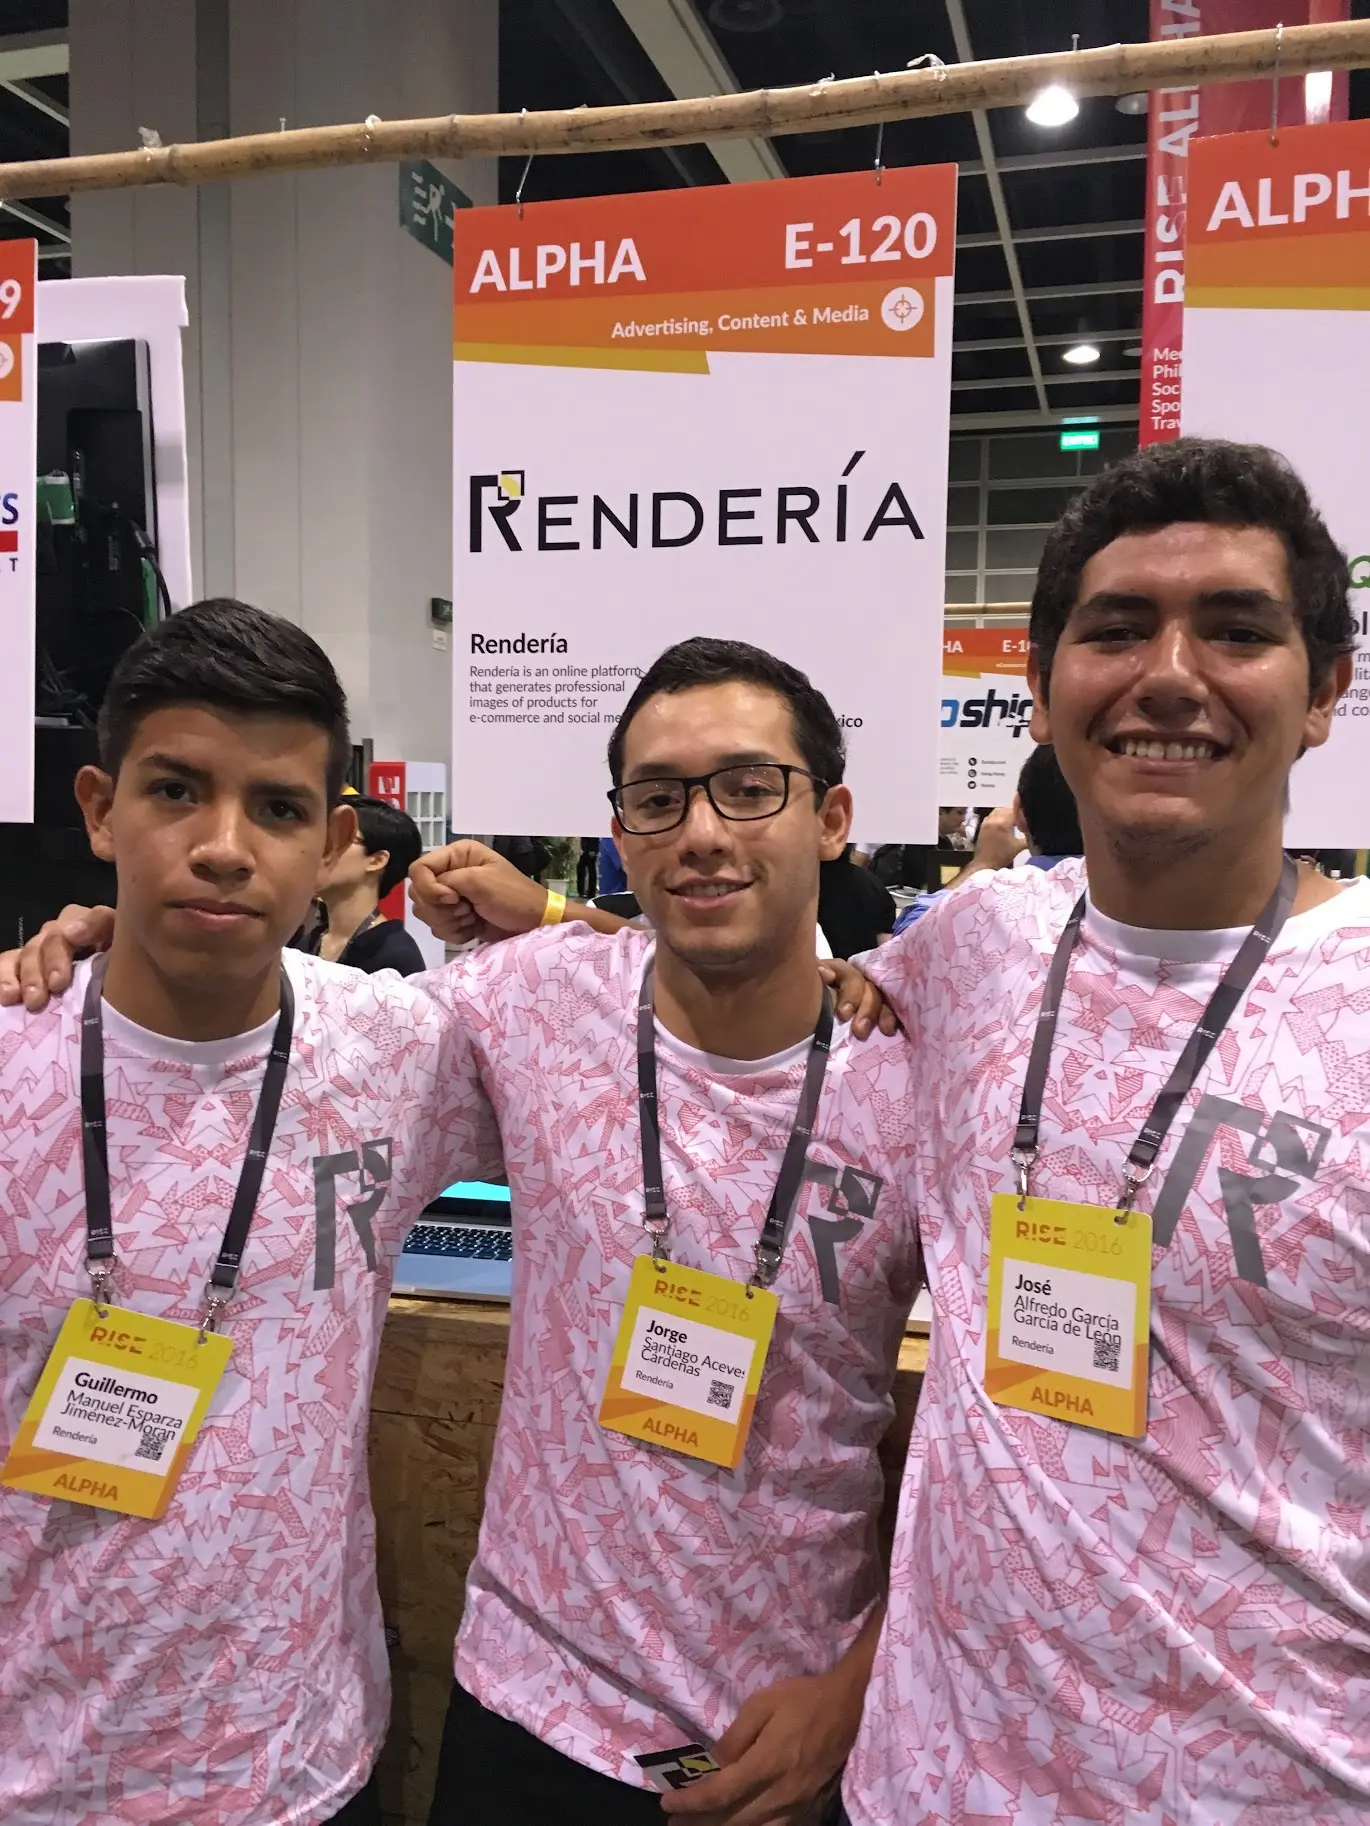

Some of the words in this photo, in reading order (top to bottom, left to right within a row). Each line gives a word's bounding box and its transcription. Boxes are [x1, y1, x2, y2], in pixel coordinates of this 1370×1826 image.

[784, 213, 938, 269] E-120
[469, 238, 647, 293] ALPHA
[0, 279, 21, 319] 9
[611, 317, 713, 338] Advertising,
[718, 311, 789, 331] Content
[794, 308, 808, 324] &
[812, 305, 870, 323] Media
[469, 450, 925, 553] RENDERÍA
[471, 633, 568, 654] Rendería
[470, 666, 519, 677] Rendería
[523, 666, 532, 677] is
[535, 668, 549, 677] an
[552, 665, 588, 677] online
[591, 665, 641, 680] platform
[469, 681, 492, 692] that
[495, 682, 551, 695] generates
[555, 681, 625, 695] professional
[469, 697, 508, 710] images
[512, 697, 524, 707] of
[527, 697, 577, 711] products
[581, 696, 599, 707] for
[469, 713, 540, 723] e-commerce
[543, 712, 564, 723] and
[568, 712, 600, 723] social
[1016, 1220, 1067, 1246] RISE
[1072, 1230, 1124, 1256] 2016
[1014, 1273, 1052, 1296] José
[654, 1279, 702, 1307] RISE
[705, 1295, 751, 1323] 2016
[1014, 1295, 1067, 1319] Alfredo
[1072, 1307, 1119, 1331] García
[646, 1320, 688, 1344] Jorge
[1013, 1309, 1058, 1331] García
[1062, 1320, 1081, 1337] de
[89, 1326, 147, 1355] RISE
[148, 1343, 199, 1370] 2016
[643, 1336, 698, 1364] Santiago
[1012, 1335, 1054, 1355] Rendería
[74, 1372, 158, 1404] Guillermo
[635, 1369, 674, 1390] Rendería
[66, 1389, 125, 1415] Manuel
[126, 1404, 183, 1429] Esparza
[1031, 1386, 1094, 1416] ALPHA
[642, 1417, 699, 1447] ALPHA
[53, 1473, 119, 1500] ALPHA
